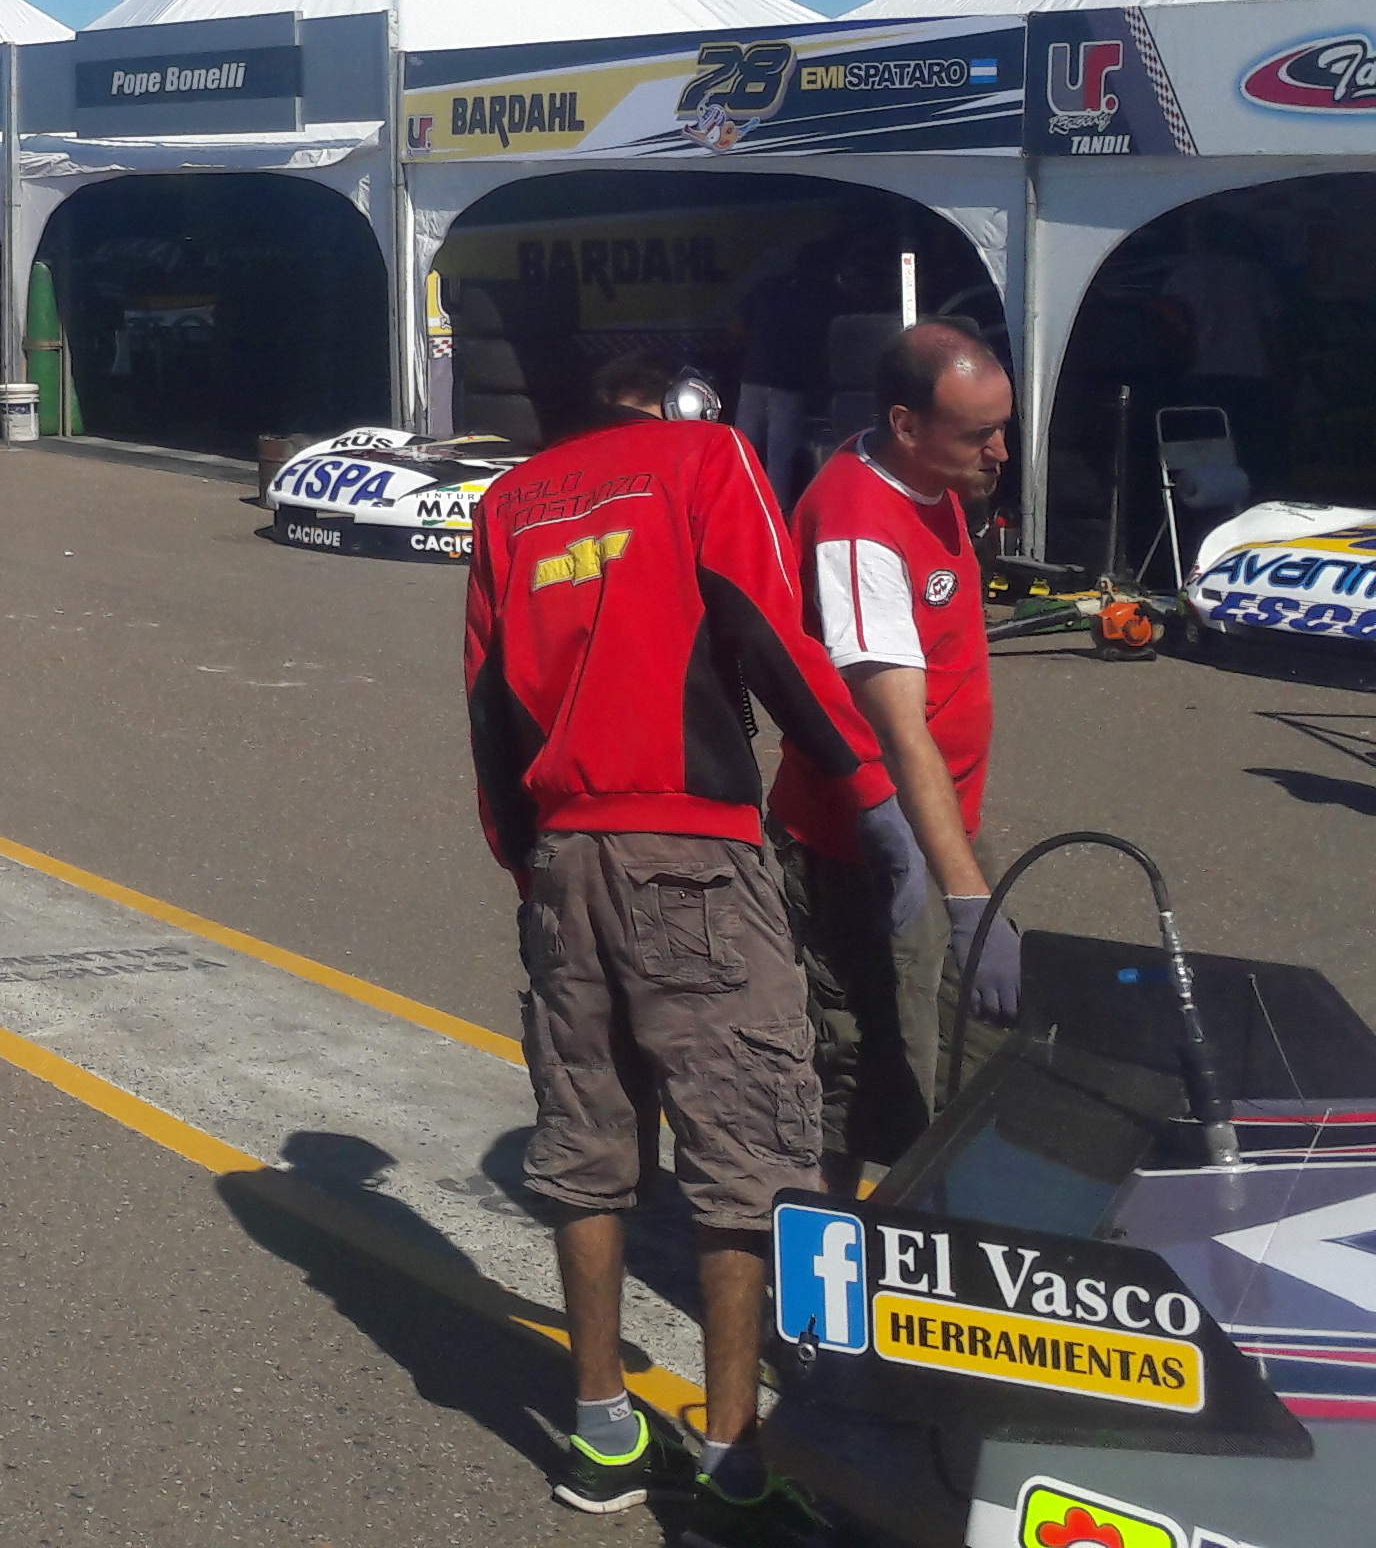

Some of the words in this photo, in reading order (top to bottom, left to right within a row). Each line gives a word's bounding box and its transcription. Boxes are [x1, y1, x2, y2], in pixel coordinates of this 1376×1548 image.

[110, 68, 163, 97] Pope
[164, 61, 247, 94] Bonelli
[675, 39, 797, 116] 28
[451, 91, 585, 149] BARDAHL
[1071, 134, 1132, 154] TANDIL
[516, 236, 731, 302] BARDAHL
[273, 459, 396, 506] FISPA
[496, 470, 584, 519] PABLO
[287, 523, 342, 548] CACIQUE
[877, 1224, 958, 1298] El
[978, 1240, 1202, 1337] Vasco
[890, 1311, 1187, 1391] HERRAMIENTAS
